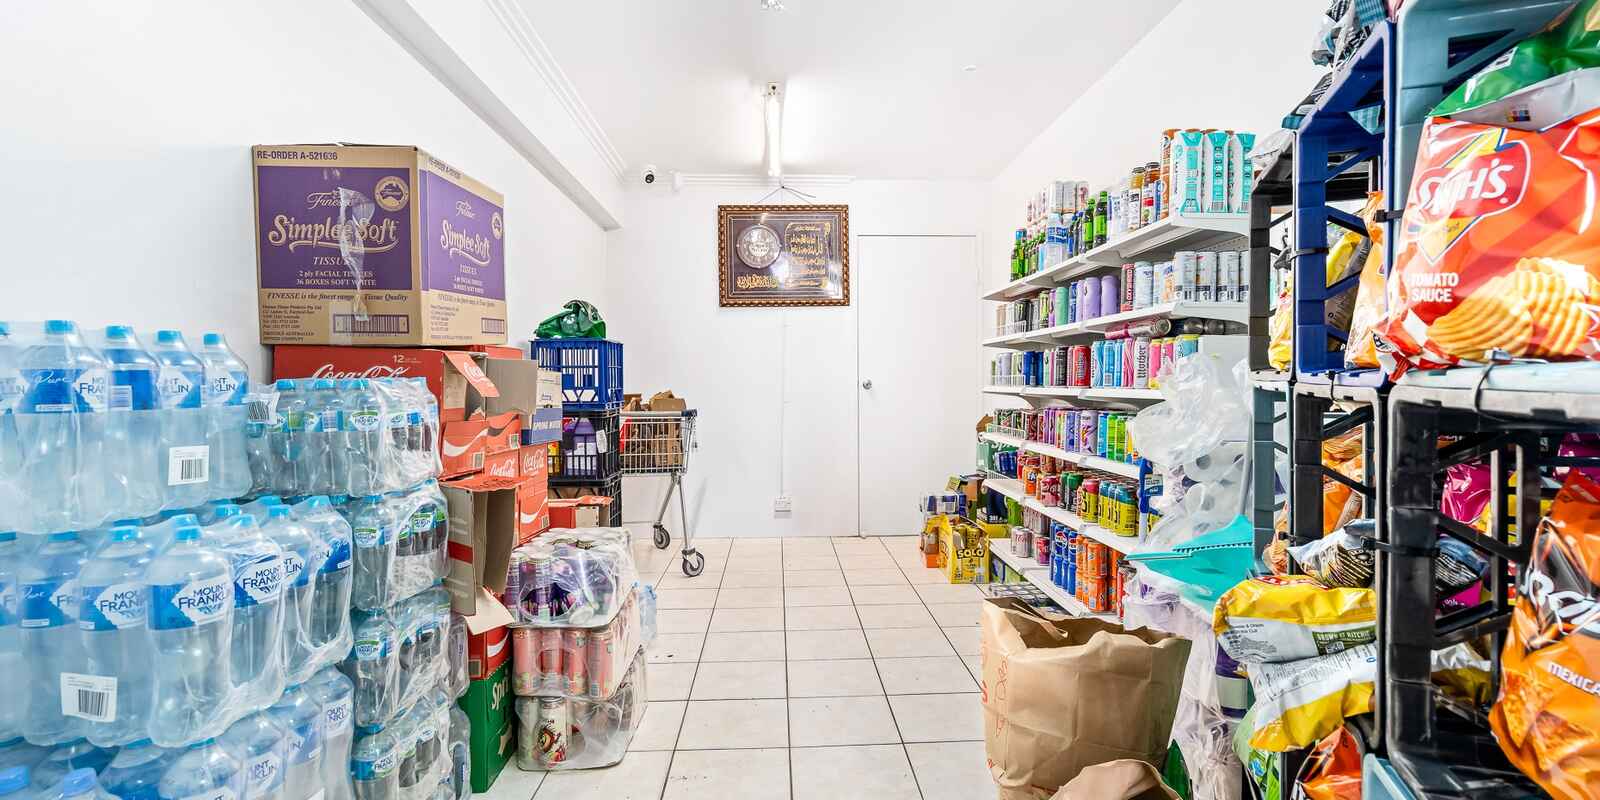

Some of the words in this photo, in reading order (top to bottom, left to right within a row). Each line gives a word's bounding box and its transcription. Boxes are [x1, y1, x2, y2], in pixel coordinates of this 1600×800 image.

[256, 151, 298, 160] RE-ORDER
[268, 214, 353, 249] Simplee
[358, 217, 398, 245] Soft
[1408, 271, 1460, 288] TOMATO
[266, 292, 301, 301] FINESSE
[308, 293, 318, 301] the
[1410, 287, 1454, 304] SAUCE
[392, 355, 404, 364] 12
[957, 548, 985, 559] SOLO
[242, 574, 282, 590] FRANK
[193, 583, 226, 598] MOUN
[177, 594, 226, 610] FRANK
